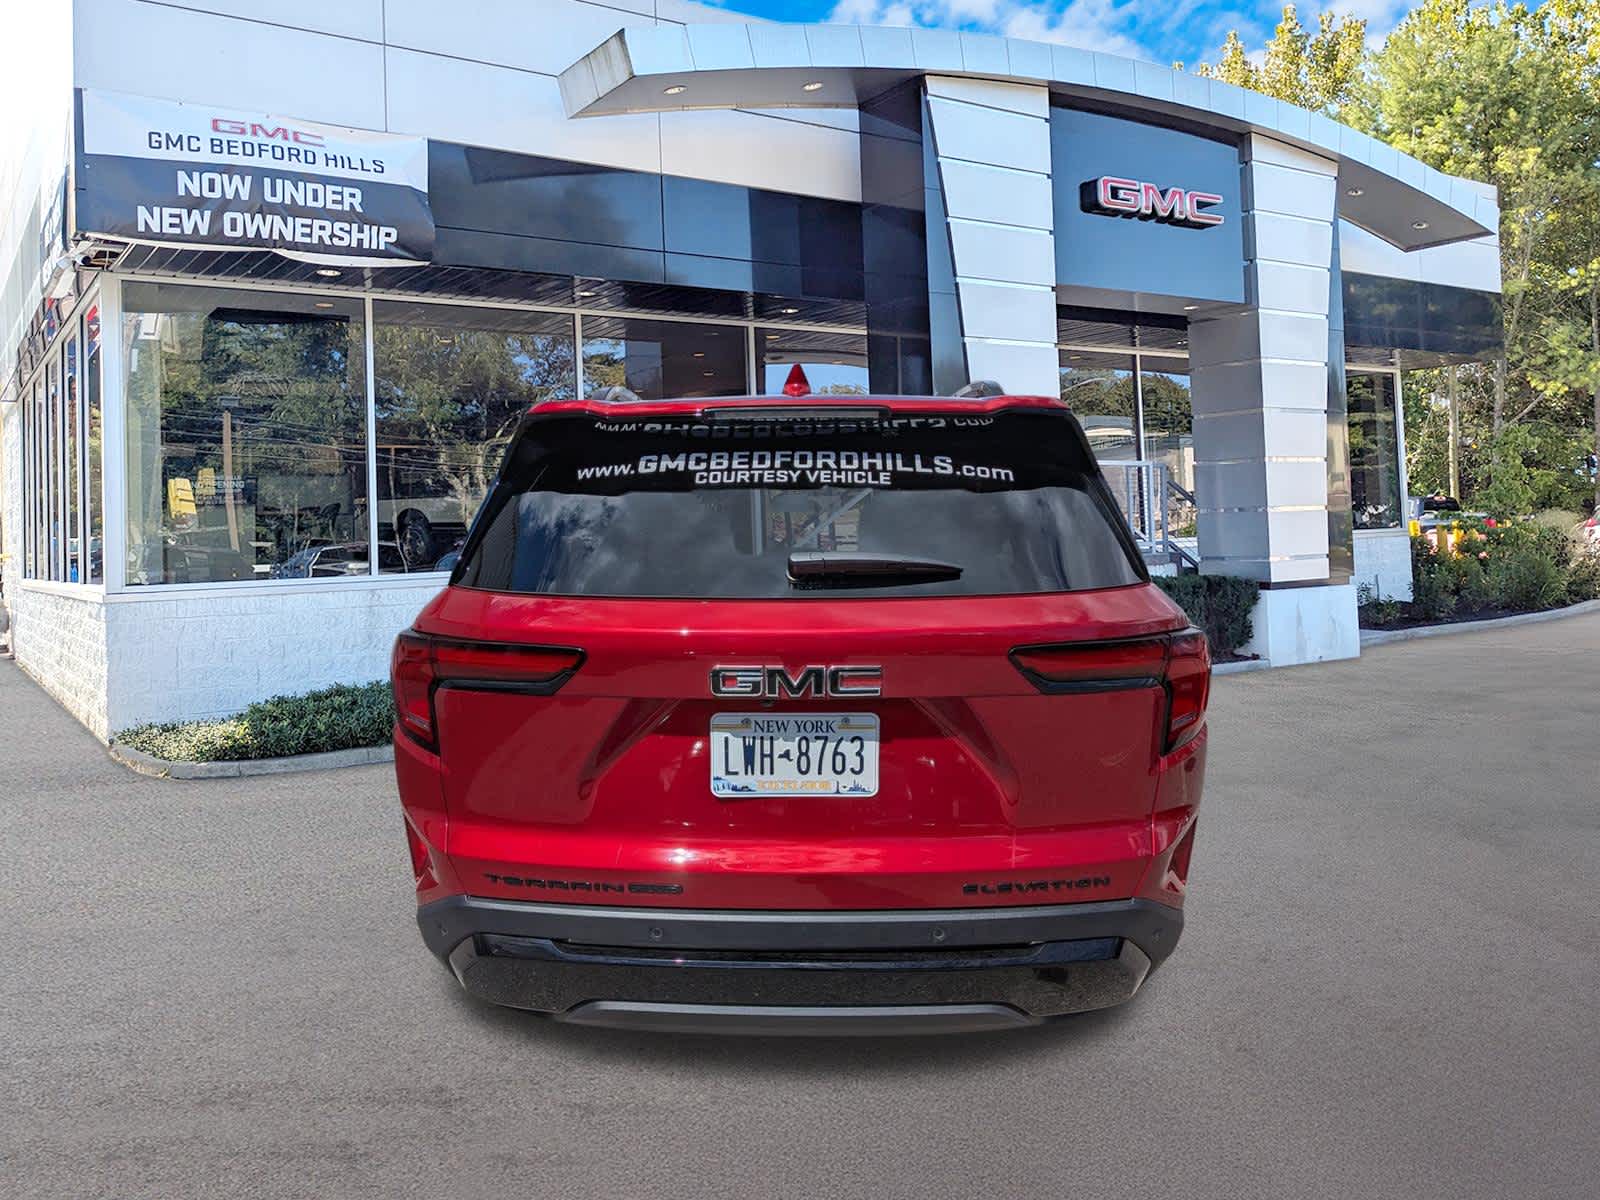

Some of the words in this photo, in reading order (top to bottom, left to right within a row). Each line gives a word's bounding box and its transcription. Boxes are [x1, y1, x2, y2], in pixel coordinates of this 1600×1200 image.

[211, 118, 326, 148] GMC
[148, 131, 201, 152] GMC
[210, 138, 317, 165] BEDFORD
[325, 153, 385, 174] HILLS
[176, 170, 252, 201] NOW
[263, 176, 364, 213] UNDER
[1097, 175, 1225, 225] GMC
[136, 205, 211, 236] NEW
[223, 211, 398, 250] OWNERSHIP
[576, 450, 1015, 482] www.GMCBEDFORDHILLS.com
[695, 470, 802, 485] COURTESY
[806, 470, 892, 485] VEHICLE
[711, 665, 882, 697] GMC
[753, 719, 794, 733] NEW
[795, 719, 836, 733] YORK
[962, 876, 1111, 895] ELEVATION
